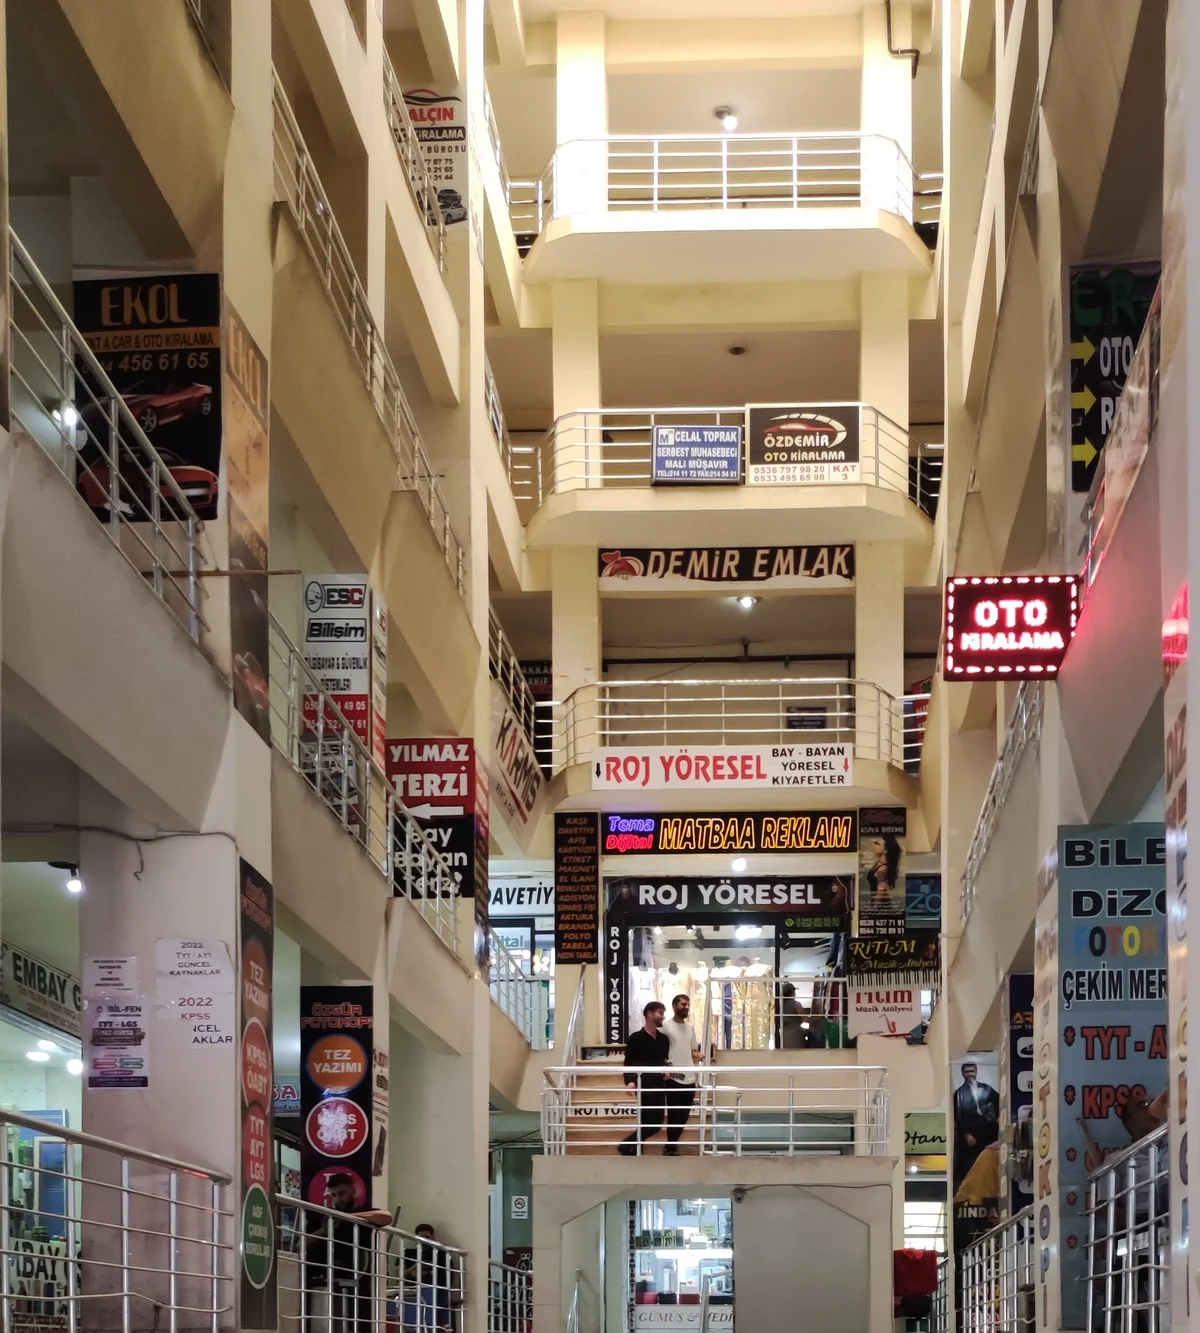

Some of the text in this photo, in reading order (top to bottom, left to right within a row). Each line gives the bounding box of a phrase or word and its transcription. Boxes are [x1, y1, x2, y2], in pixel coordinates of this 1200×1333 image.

[102, 283, 187, 327] EKOL
[112, 334, 131, 348] CAR
[143, 334, 162, 347] OTO
[119, 351, 209, 371] 456 61 65
[1100, 336, 1134, 377] OTO
[675, 430, 738, 443] CELAL TOPRAK
[764, 431, 829, 448] ÖZDEMİR
[657, 447, 689, 457] SERBEST
[764, 450, 846, 462] OTO KİRALAMA
[800, 466, 811, 474] 98
[814, 465, 825, 473] 20
[649, 547, 850, 579] DEMİR EMLAK
[326, 588, 363, 604] ESC
[974, 599, 1048, 628] OTO
[309, 622, 365, 639] Bilişim
[356, 701, 366, 710] 05
[390, 744, 470, 762] YILMAZ
[772, 747, 845, 757] BAY BAYAN
[606, 748, 767, 786] ROJ YÖRESEL
[782, 758, 835, 771] YÖRESEL
[392, 765, 468, 797] TERZİ
[772, 775, 845, 785] KIYAFETLER
[609, 816, 655, 832] Tema
[659, 818, 755, 850] MATBAA
[761, 816, 852, 849] REKLAM
[639, 879, 821, 910] ROJ YÖRESEL
[12, 952, 67, 1005] EMBAY
[1062, 963, 1123, 1010] ÇEKİM
[178, 997, 213, 1007] 2022
[121, 1020, 138, 1028] LGS
[1081, 1026, 1130, 1060] TYT
[324, 1049, 352, 1060] TEZ
[313, 1062, 362, 1074] YAZIMI
